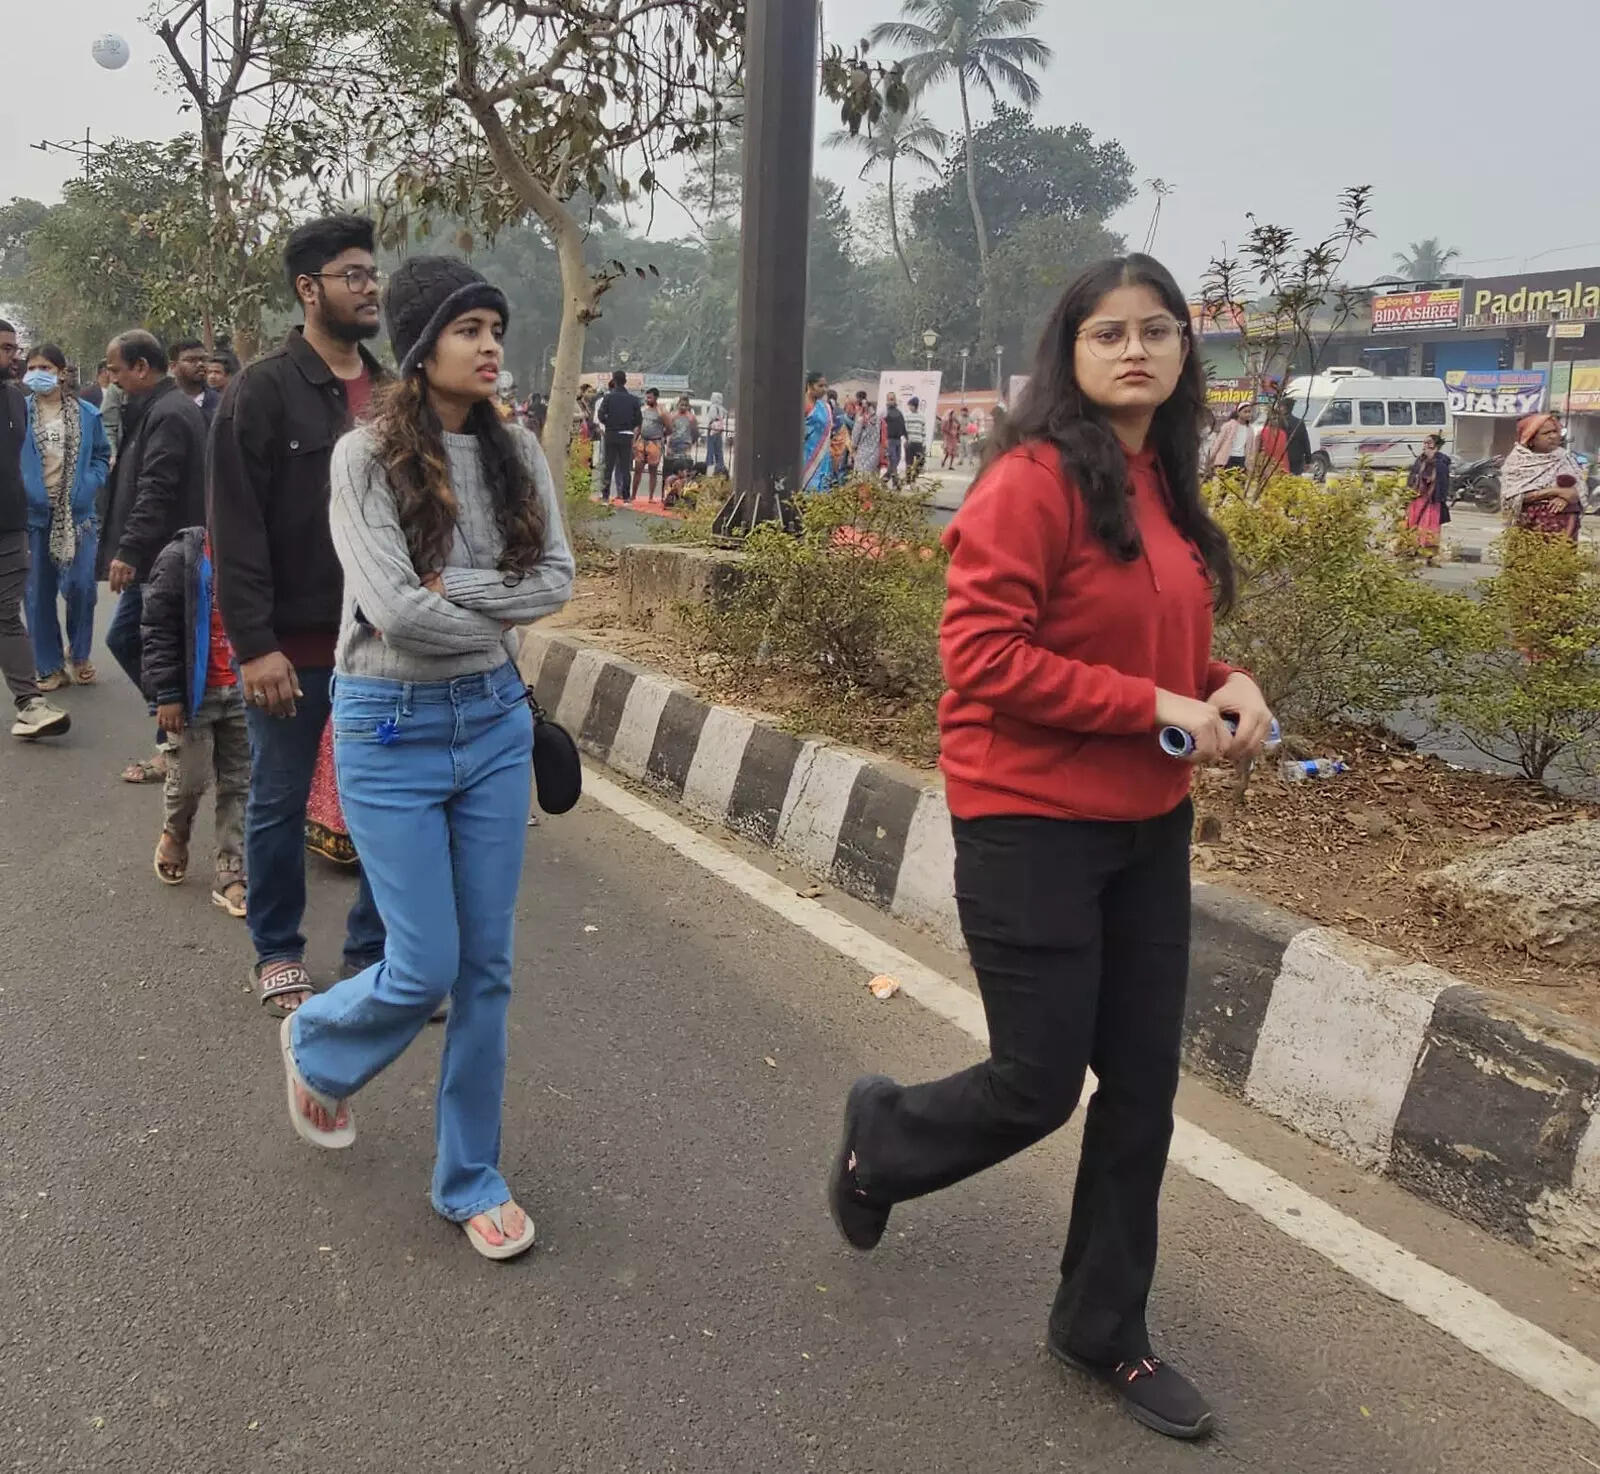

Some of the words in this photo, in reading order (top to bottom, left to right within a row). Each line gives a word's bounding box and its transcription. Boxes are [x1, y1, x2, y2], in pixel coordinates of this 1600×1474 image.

[1475, 281, 1600, 315] Padmala
[1374, 303, 1457, 323] BIDYASHREE
[1448, 391, 1540, 413] DIARY
